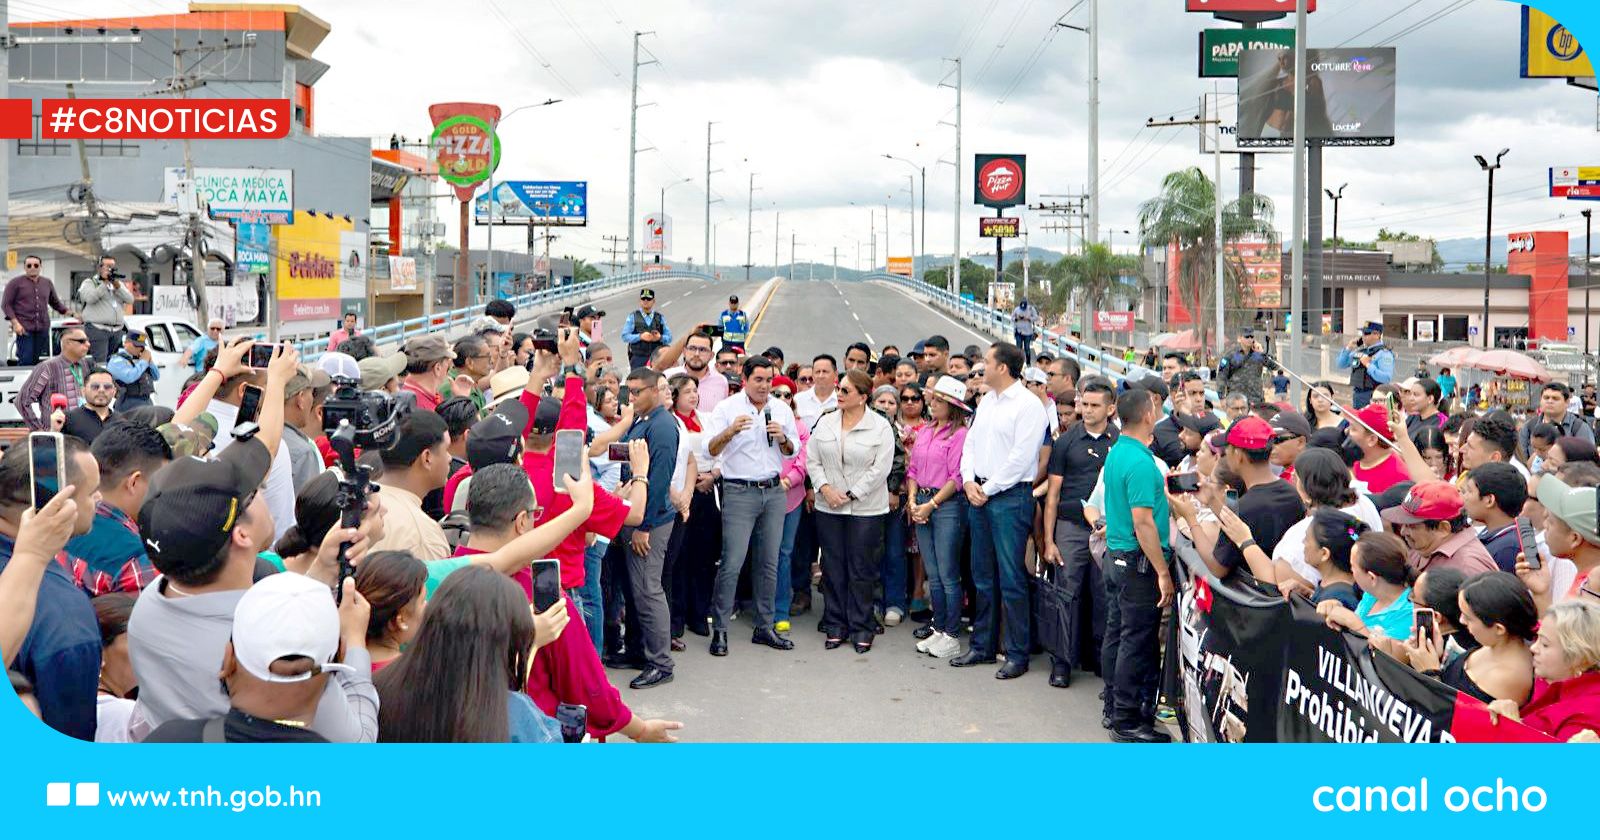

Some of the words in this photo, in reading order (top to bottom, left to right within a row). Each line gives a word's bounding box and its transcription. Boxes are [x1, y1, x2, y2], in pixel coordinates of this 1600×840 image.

[1212, 41, 1244, 57] PAPA
[1311, 62, 1352, 72] OCTUBRE
[451, 126, 478, 135] GOLD
[987, 175, 1013, 188] Pizza
[991, 183, 1011, 194] Hut
[243, 189, 289, 203] MAYA
[1318, 645, 1432, 743] VILLANUEVA
